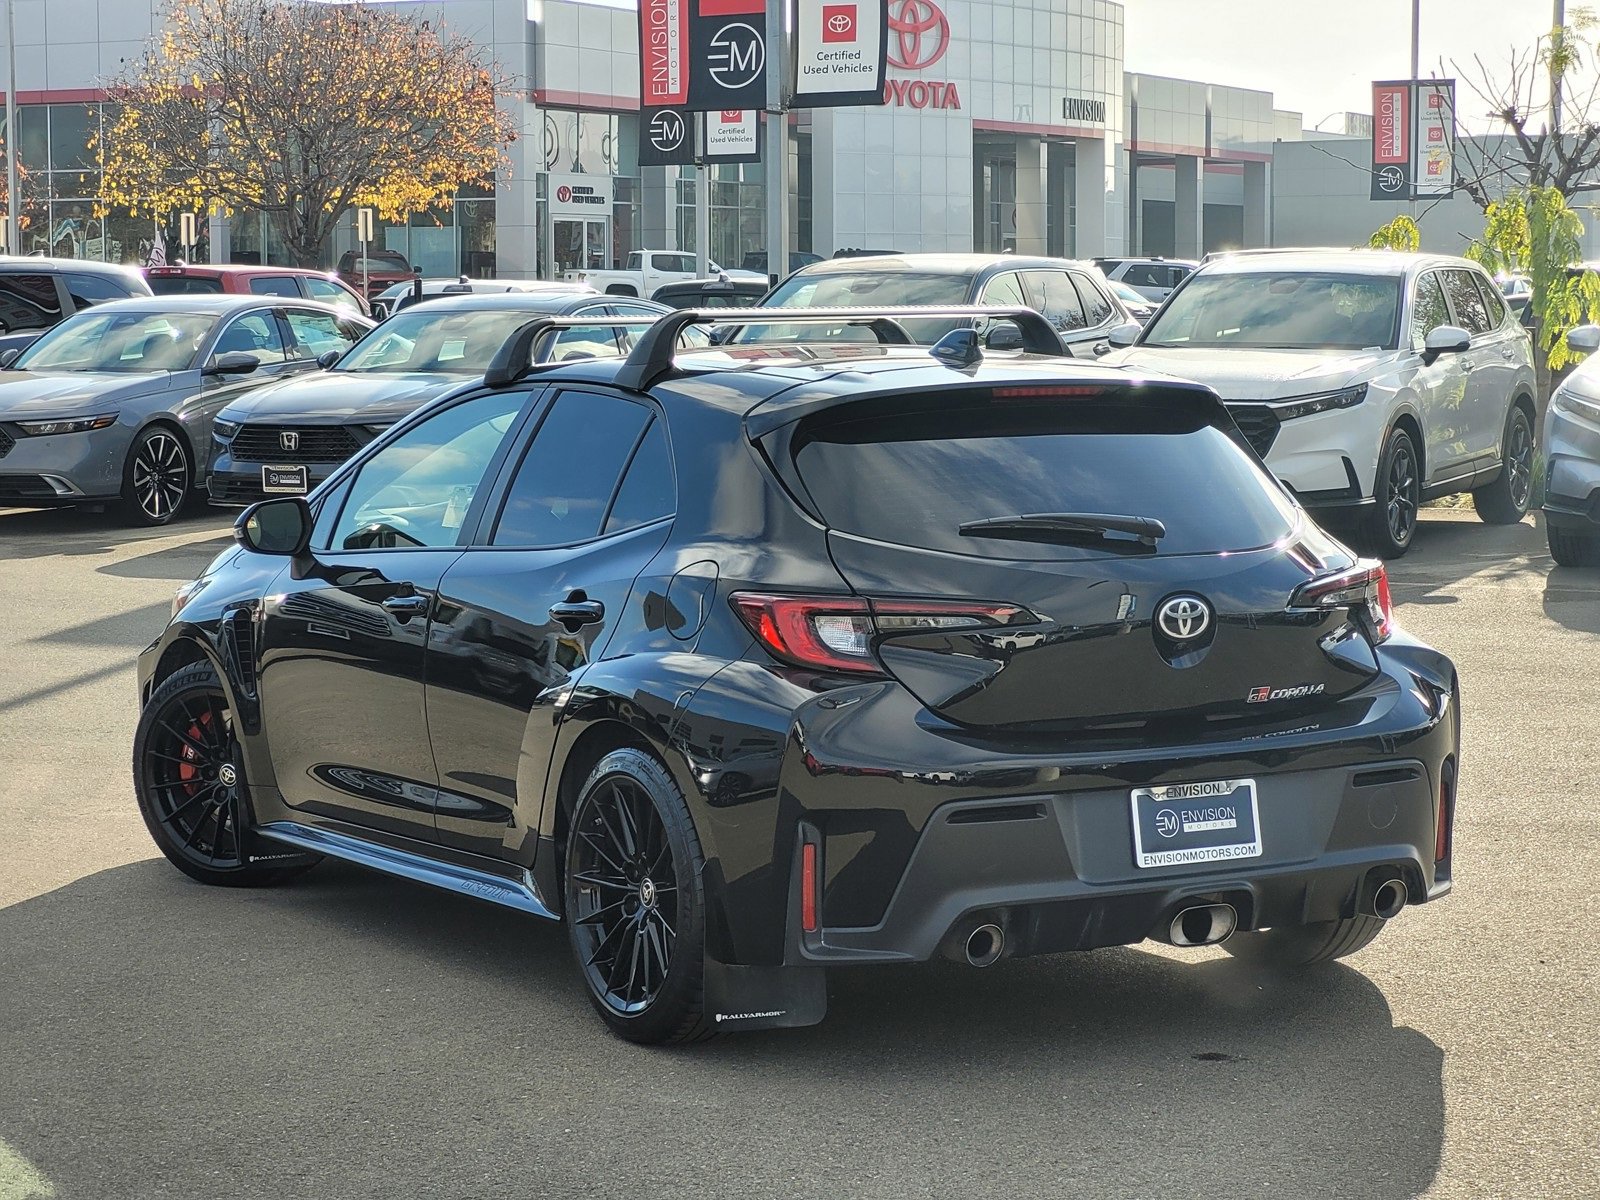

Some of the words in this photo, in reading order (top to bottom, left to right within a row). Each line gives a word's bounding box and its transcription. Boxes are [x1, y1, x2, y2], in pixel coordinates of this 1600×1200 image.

[816, 49, 861, 61] Certified
[803, 64, 829, 75] Used
[831, 62, 873, 73] Vehicles
[1062, 97, 1106, 122] ENVISION
[717, 127, 746, 135] Certified
[1382, 92, 1392, 158] ENVISION
[727, 134, 753, 142] Vehicles
[1166, 783, 1220, 798] ENVISION
[1181, 806, 1236, 823] ENVISION
[1187, 821, 1234, 830] MOTORS
[1143, 845, 1257, 865] ENVISIONMOTORS.COM
[721, 1011, 781, 1020] RALLYARMOR
